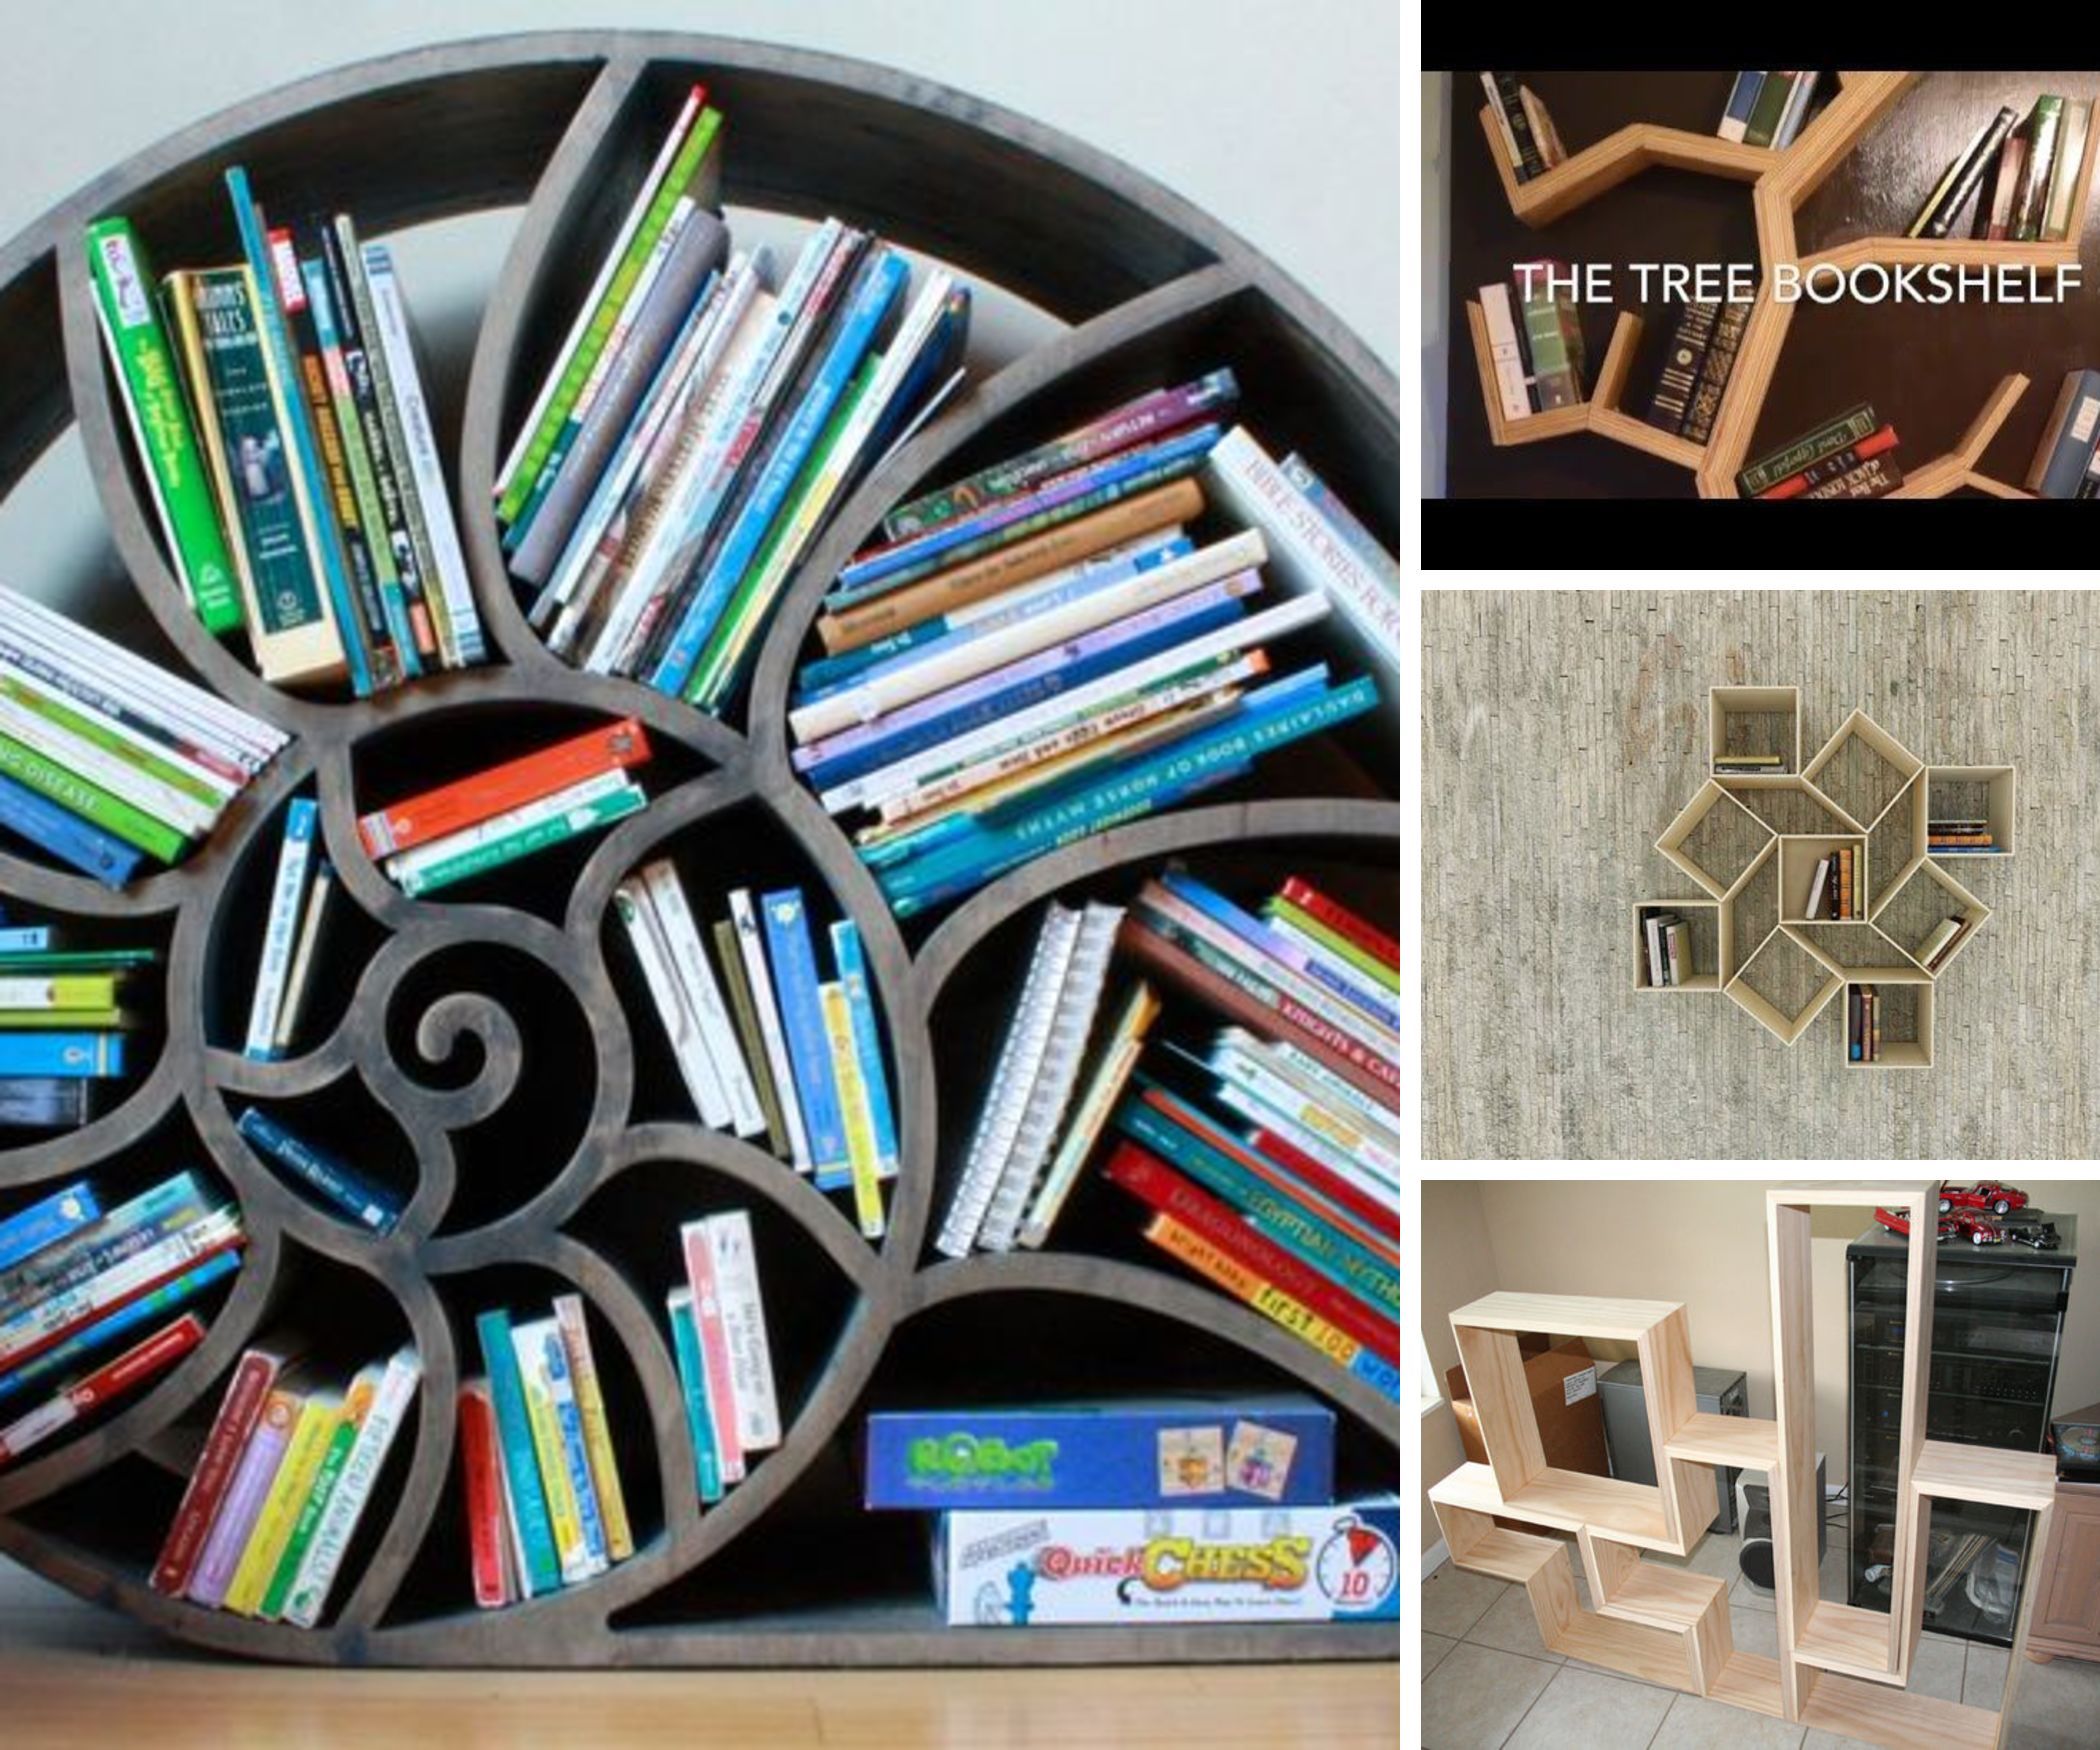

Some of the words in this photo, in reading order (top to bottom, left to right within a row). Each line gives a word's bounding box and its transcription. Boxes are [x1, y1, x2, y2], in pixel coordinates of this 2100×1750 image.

[1165, 756, 1193, 778] OF
[1195, 735, 1247, 767] BOOK
[1092, 770, 1158, 808] NORSE
[1012, 799, 1087, 841] MYTHS
[1364, 1055, 1400, 1087] CAS
[1313, 1326, 1356, 1361] 100
[1039, 1546, 1146, 1580] Quick
[1341, 1572, 1369, 1597] 10
